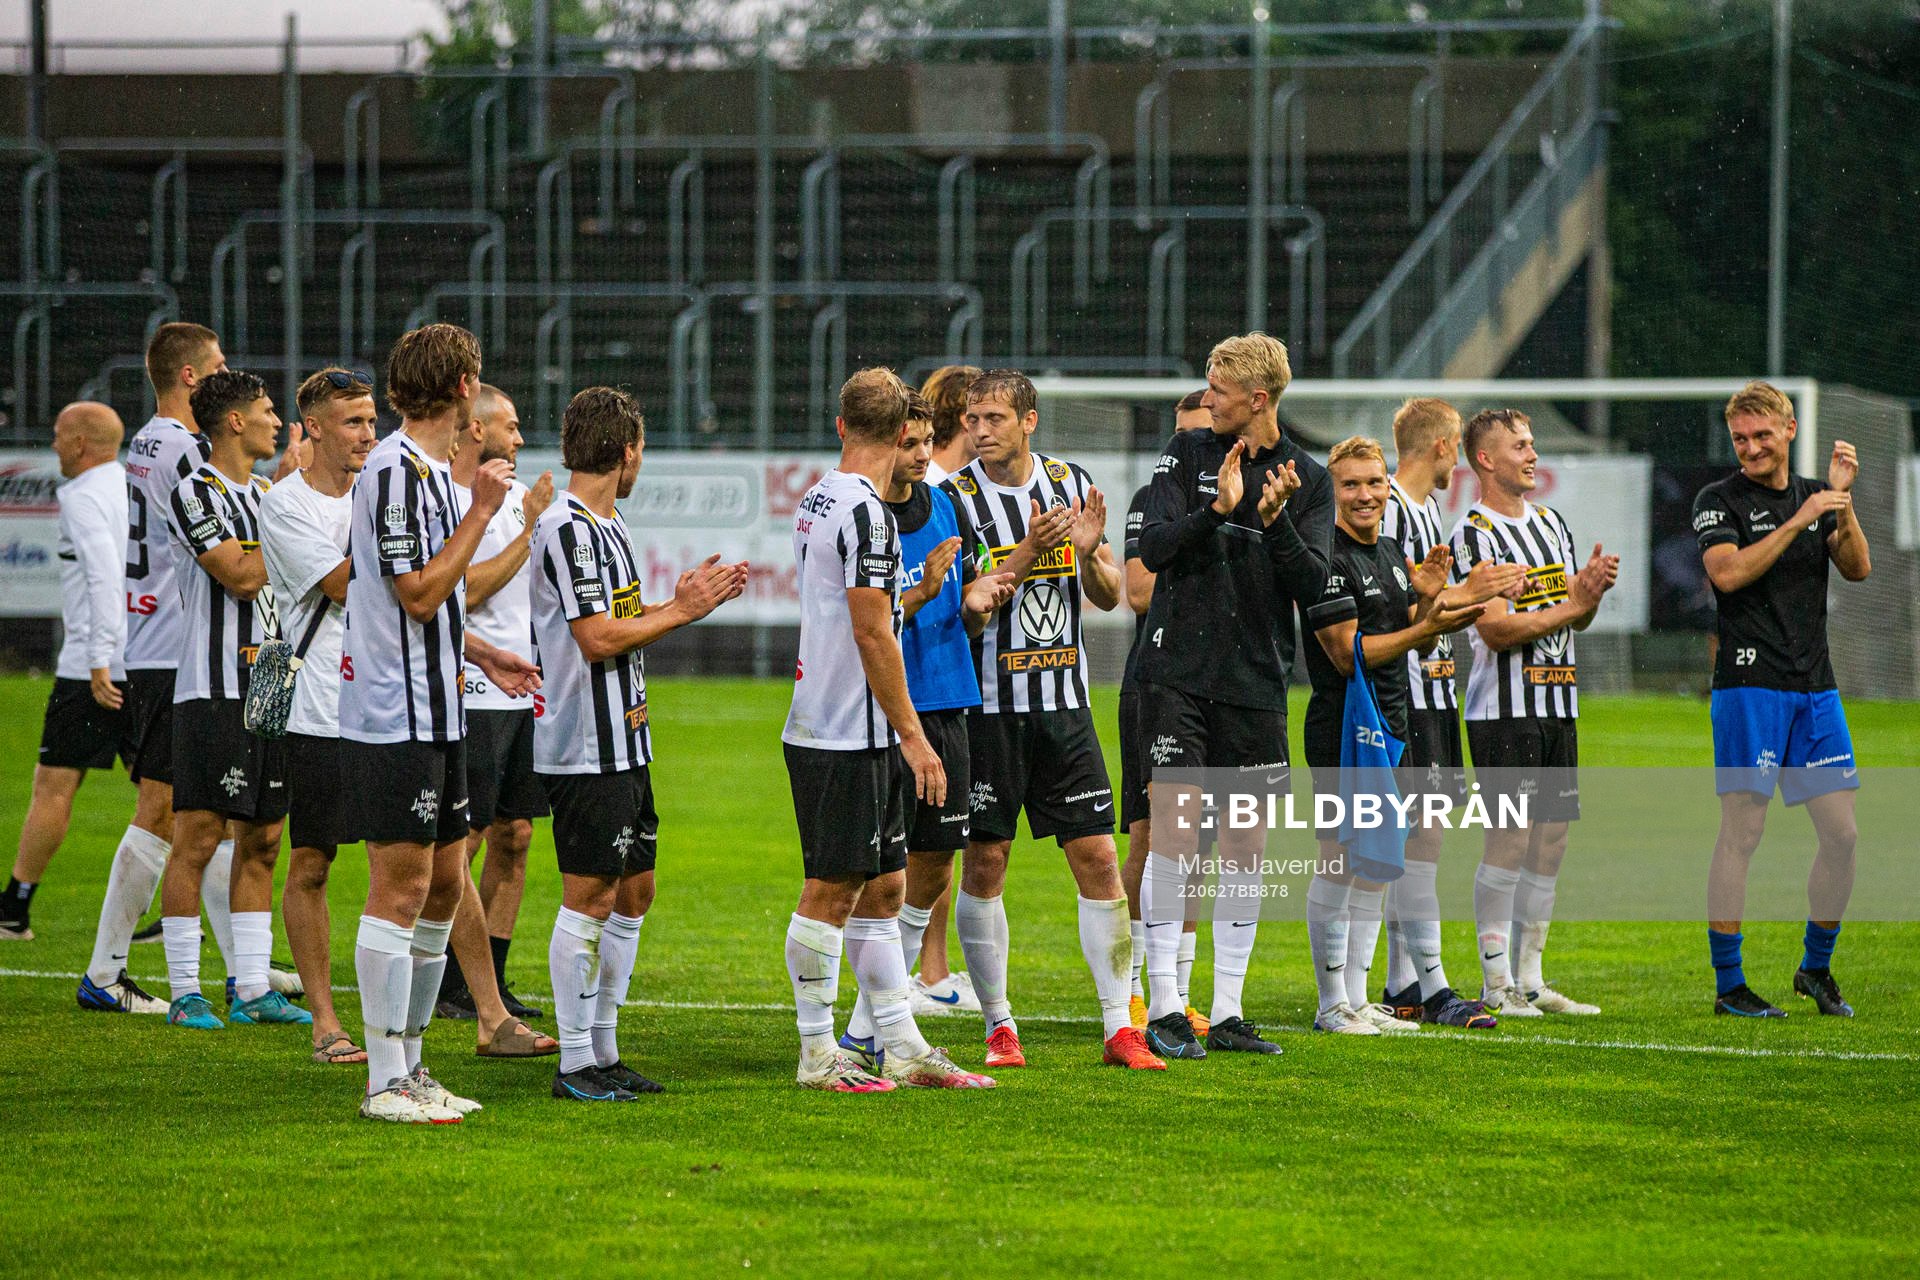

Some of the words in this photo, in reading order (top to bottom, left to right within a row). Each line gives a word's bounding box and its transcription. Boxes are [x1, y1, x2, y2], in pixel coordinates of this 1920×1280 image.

[190, 519, 219, 538] UNIBET
[381, 540, 415, 550] UNIBET
[863, 559, 893, 569] UNIBET
[574, 583, 603, 594] UNIBET
[1152, 627, 1164, 648] 4
[998, 647, 1078, 671] TEAMAB
[1736, 648, 1757, 666] 29
[1524, 666, 1577, 684] TEAMA
